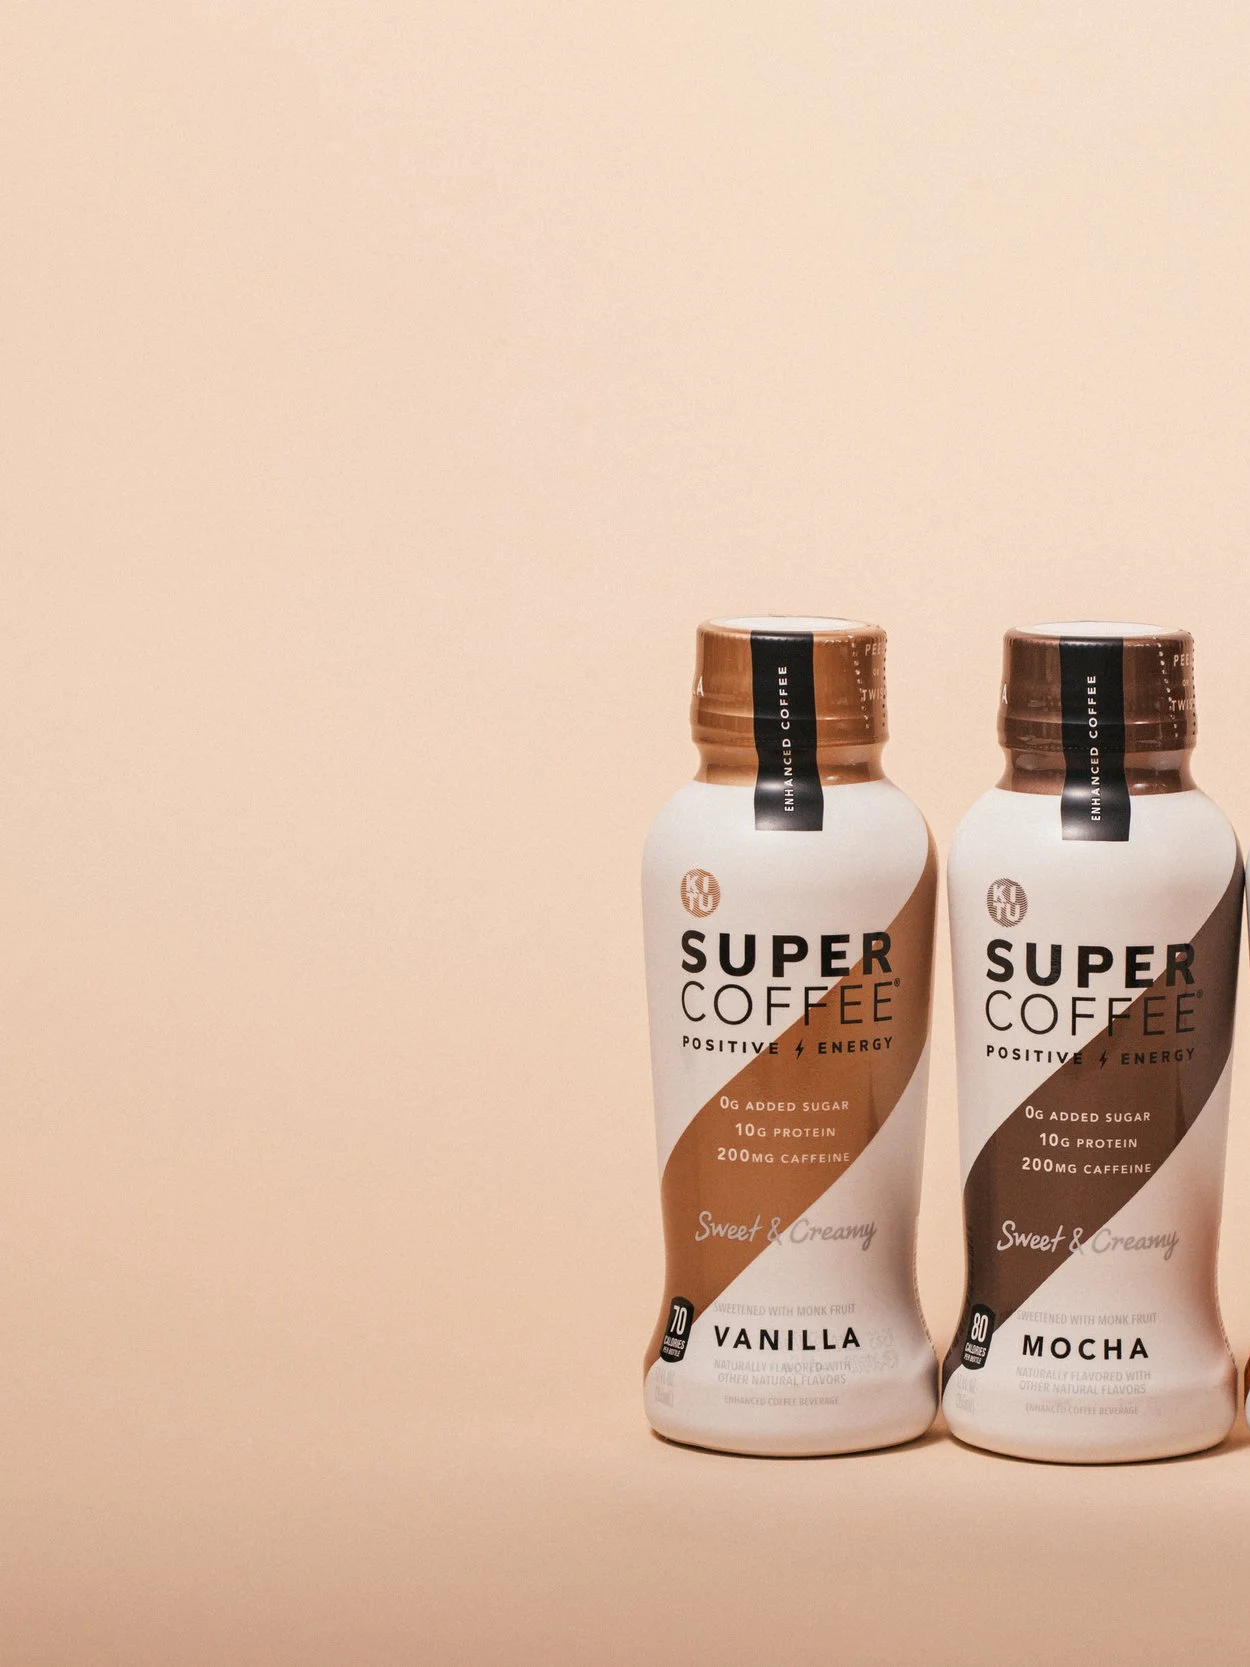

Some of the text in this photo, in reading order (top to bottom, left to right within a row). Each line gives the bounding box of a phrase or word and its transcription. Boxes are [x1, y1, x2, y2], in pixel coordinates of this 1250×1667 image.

[778, 666, 794, 812] ENHANCED COFFEE
[1087, 675, 1100, 821] ENHANCED COFFEE
[681, 930, 892, 977] SUPER
[986, 939, 1195, 988] SUPER
[681, 981, 892, 1026] COFFEE
[985, 990, 1195, 1036] COFFEE
[683, 1035, 893, 1054] POSITIVE ENERGY
[986, 1045, 1195, 1065] POSITIVE ENERGY
[720, 1096, 849, 1112] 0G ADDED SUGAR
[1025, 1106, 1151, 1123] 0G ADDED SUGAR
[735, 1123, 835, 1138] 10G PROTEIN
[1040, 1133, 1137, 1149] 10G PROTEIN
[717, 1148, 850, 1164] 200MG CAFFEINE
[1022, 1157, 1151, 1175] 200MG CAFFEINE
[695, 1211, 878, 1250] Sweet & Creamy
[997, 1220, 1179, 1260] Sweet & Creamy
[713, 1302, 856, 1317] SWEETENED WITH MONK FRUIT
[1016, 1309, 1157, 1326] SWEETENED WITH MONK FRUIT
[671, 1305, 687, 1335] 70
[971, 1312, 988, 1342] 80
[714, 1325, 861, 1351] VANILLA
[1022, 1334, 1149, 1360] MOCHA
[714, 1359, 767, 1372] NATURALLY
[770, 1361, 822, 1373] FLAVORED
[824, 1359, 851, 1371] WITH
[1016, 1366, 1151, 1382] NATURALLY FLAVORED WITH
[718, 1373, 846, 1387] OTHER NATURAL FLAVORS
[1019, 1380, 1146, 1395] OTHER NATURAL FLAVORS
